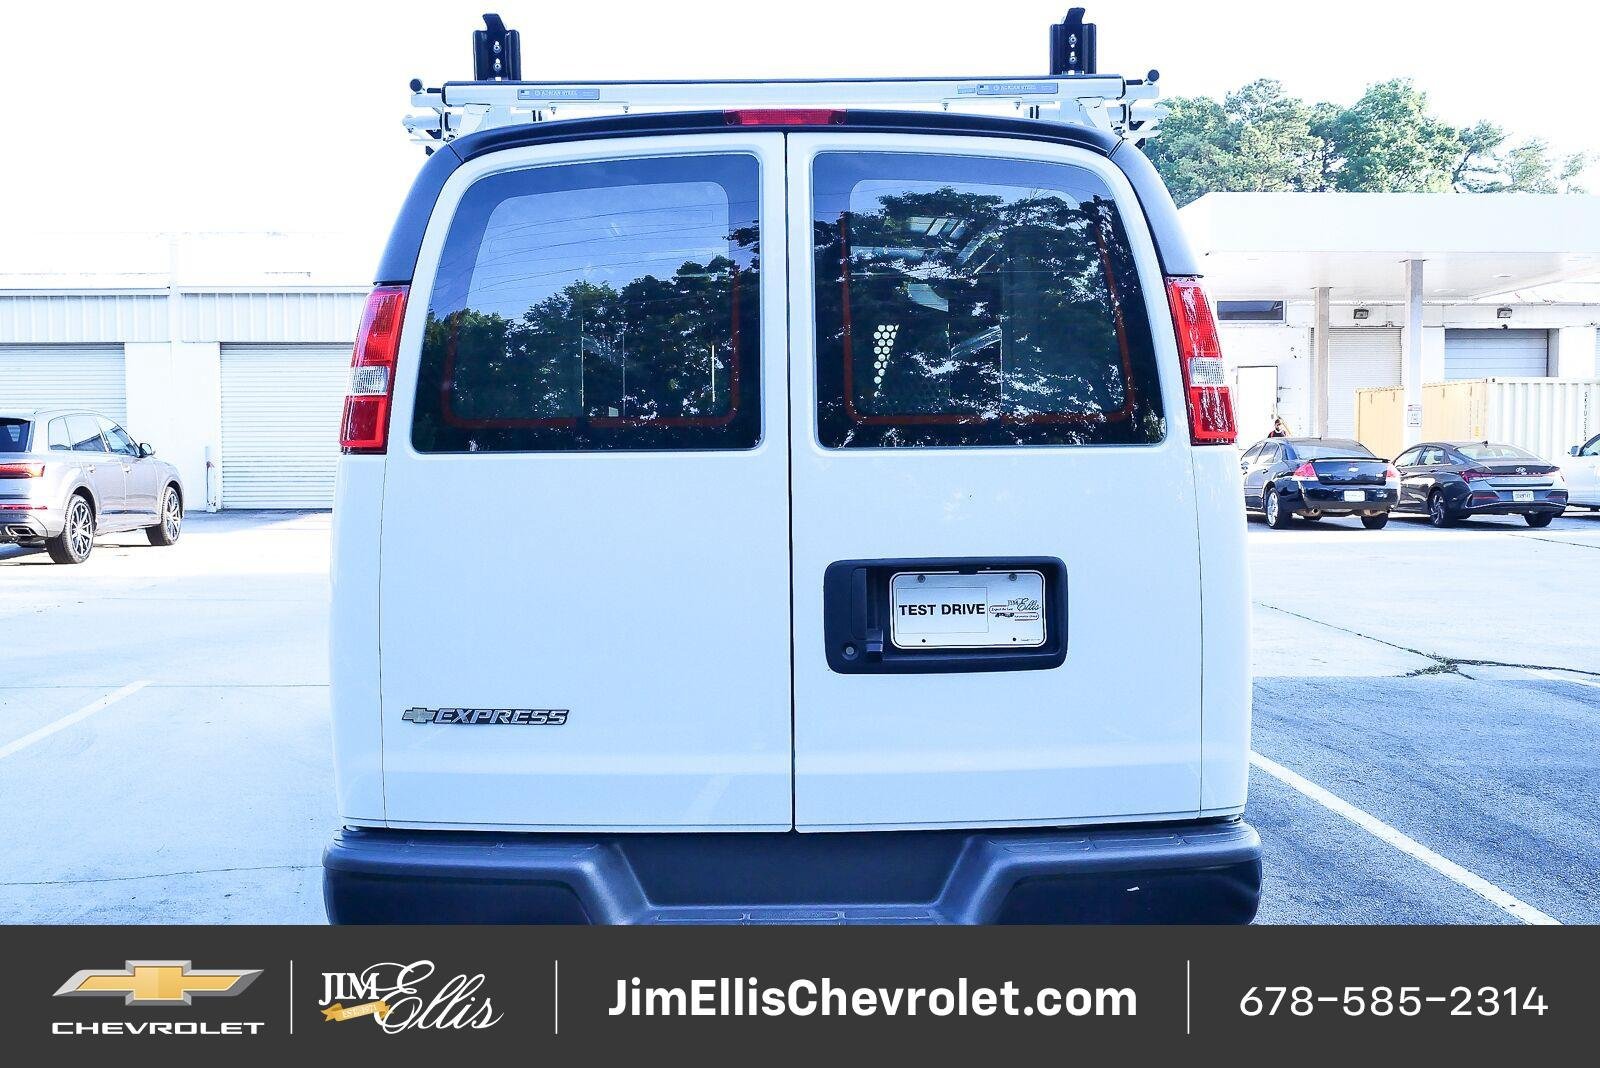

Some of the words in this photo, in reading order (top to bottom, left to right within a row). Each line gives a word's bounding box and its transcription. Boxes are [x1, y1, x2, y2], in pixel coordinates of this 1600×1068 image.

[898, 604, 937, 616] TEST
[941, 603, 986, 615] DRIVE
[1016, 597, 1041, 611] Ellis
[434, 708, 569, 725] EXPRESS
